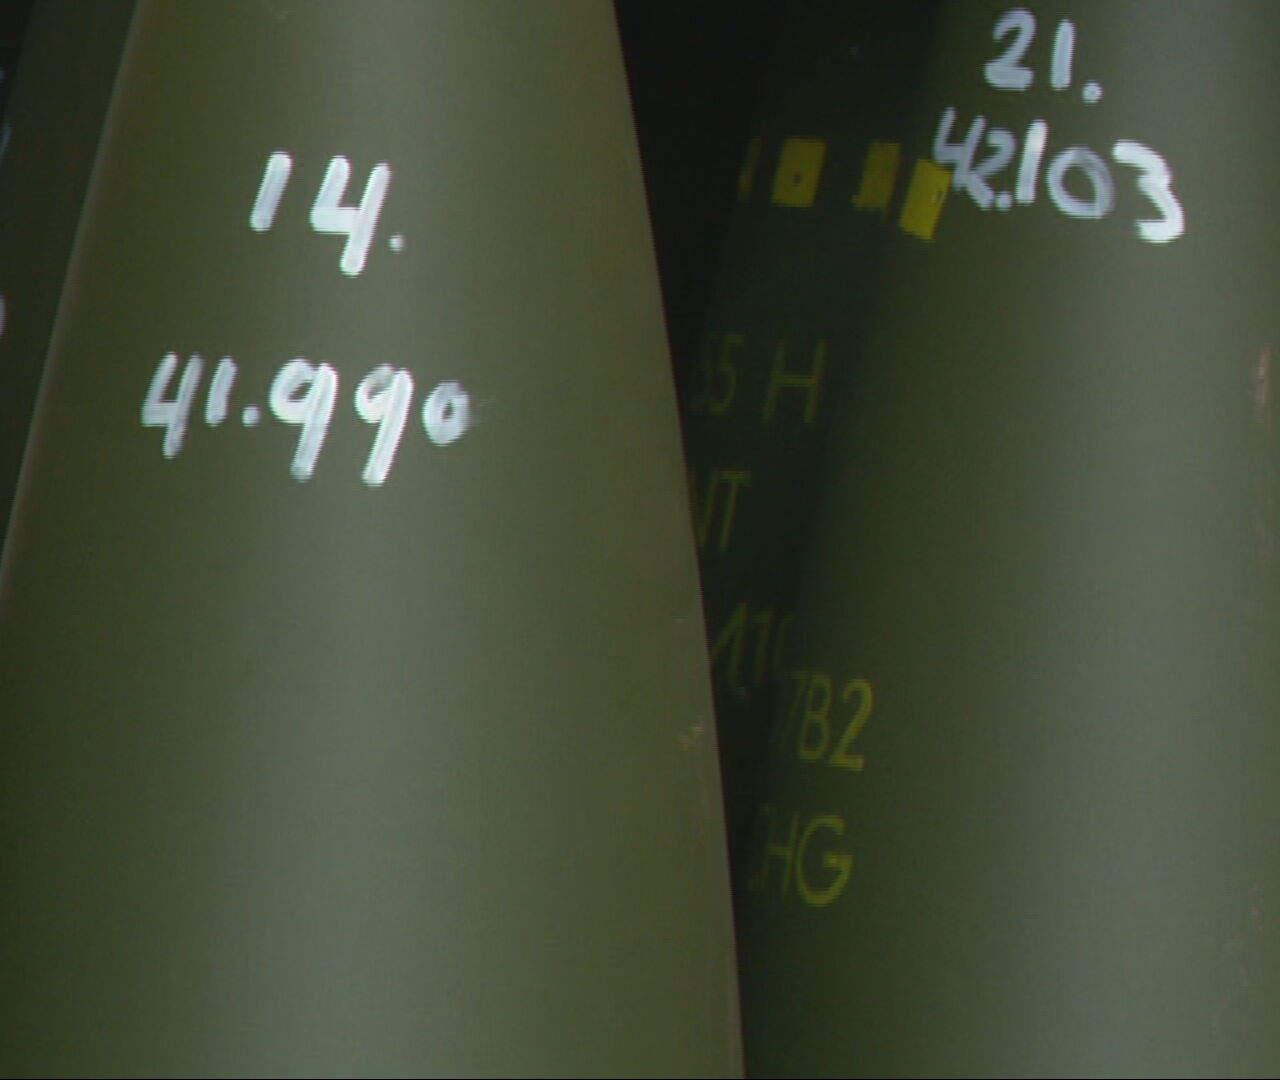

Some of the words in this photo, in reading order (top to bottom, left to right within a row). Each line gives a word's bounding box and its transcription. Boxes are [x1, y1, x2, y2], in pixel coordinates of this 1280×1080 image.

[983, 6, 1104, 106] 21.
[249, 150, 407, 277] 14.
[932, 106, 1186, 245] 42.103
[141, 351, 471, 487] 41.990
